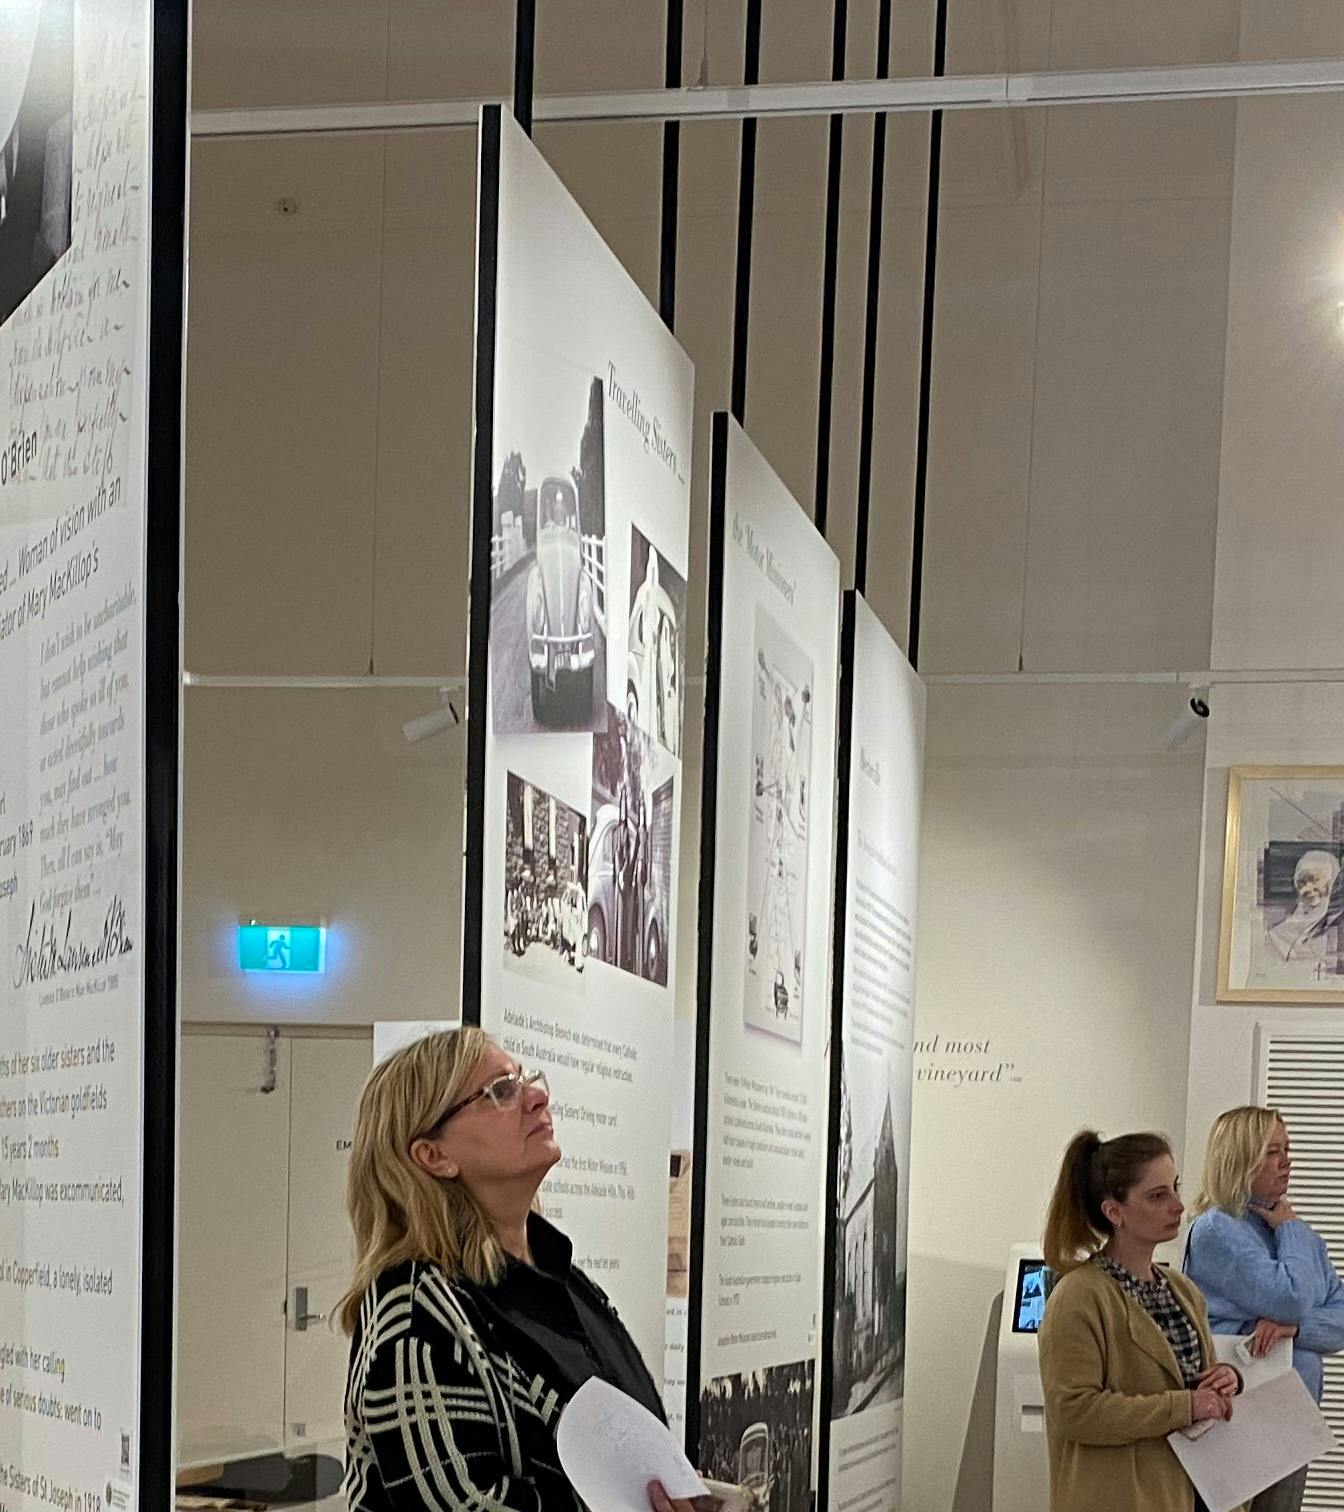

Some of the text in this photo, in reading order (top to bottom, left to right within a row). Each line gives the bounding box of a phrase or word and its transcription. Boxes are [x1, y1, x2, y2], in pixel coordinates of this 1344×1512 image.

[608, 360, 651, 455] Travelling
[651, 416, 678, 475] Sisters
[18, 536, 49, 580] Woman
[49, 516, 60, 556] of
[59, 504, 86, 548] vision
[86, 480, 107, 525] with
[108, 475, 121, 508] an
[17, 592, 27, 629] of
[26, 585, 48, 621] Mary
[17, 818, 34, 849] 1869
[945, 1039, 991, 1054] most
